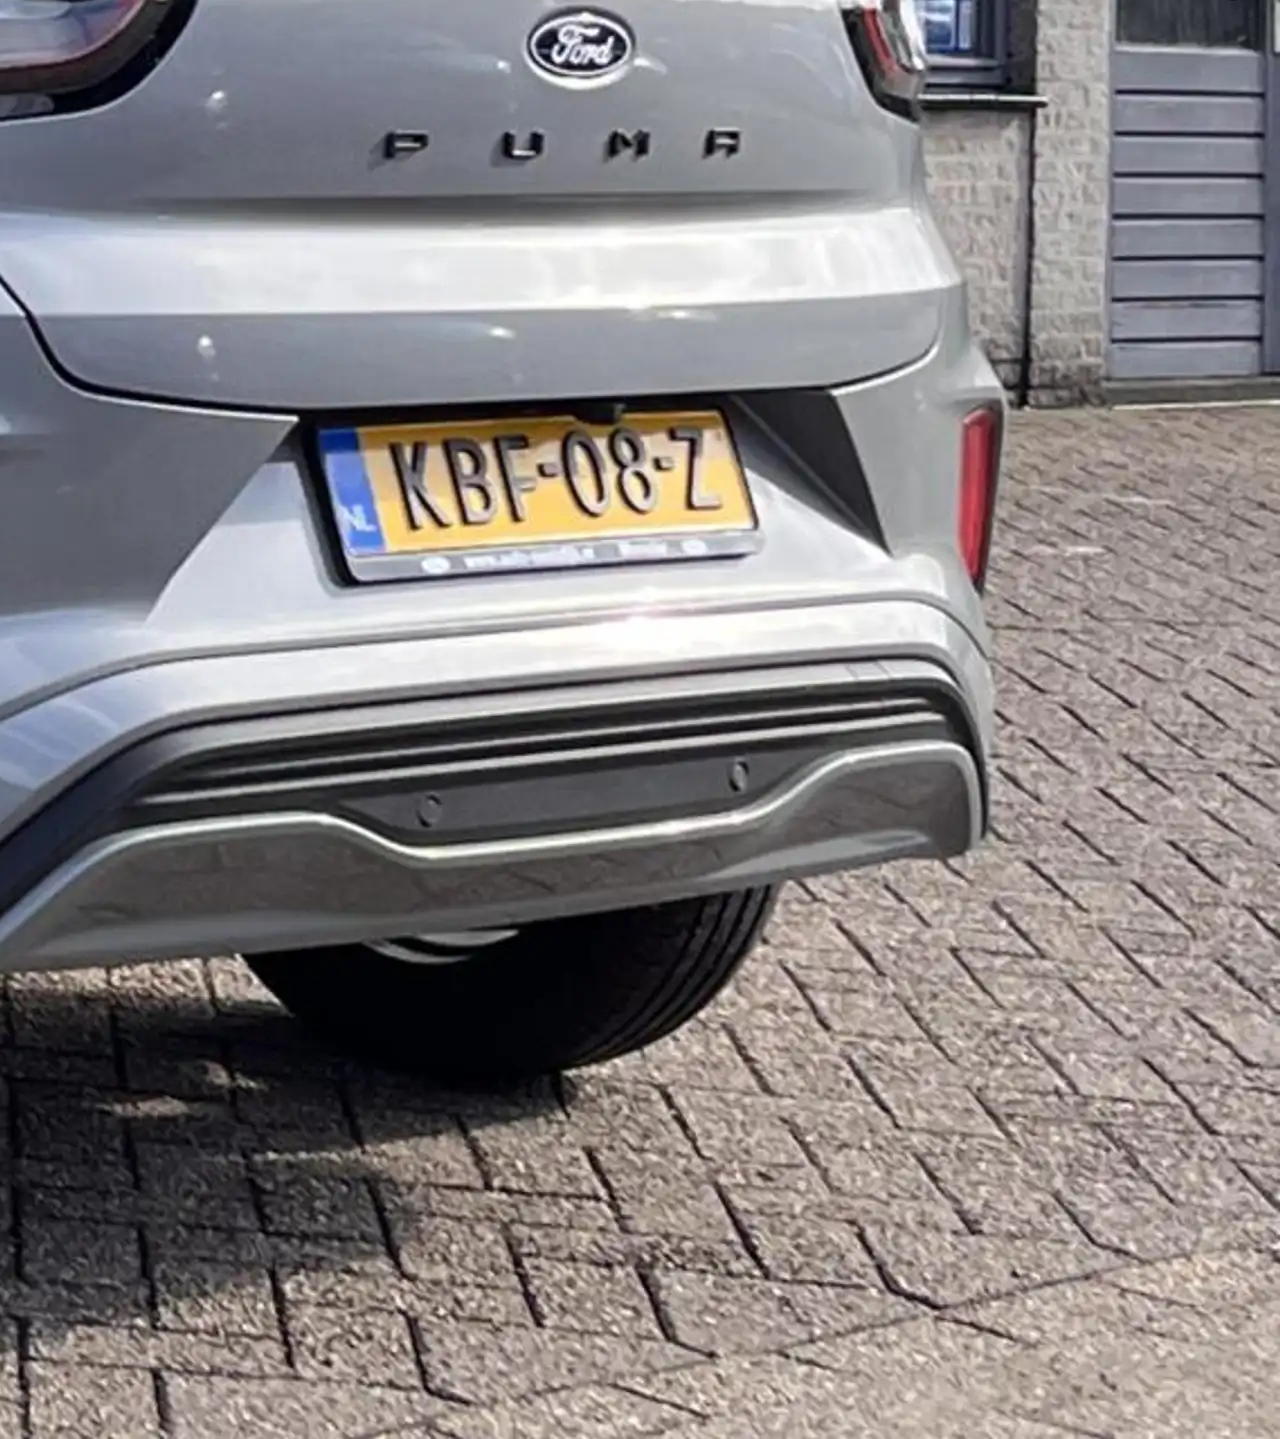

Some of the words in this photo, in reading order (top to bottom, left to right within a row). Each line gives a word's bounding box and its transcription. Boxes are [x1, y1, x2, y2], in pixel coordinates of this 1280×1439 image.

[551, 24, 615, 66] Ford
[380, 128, 742, 161] PUMA
[387, 427, 723, 531] KBF-08-Z
[337, 503, 376, 533] NL
